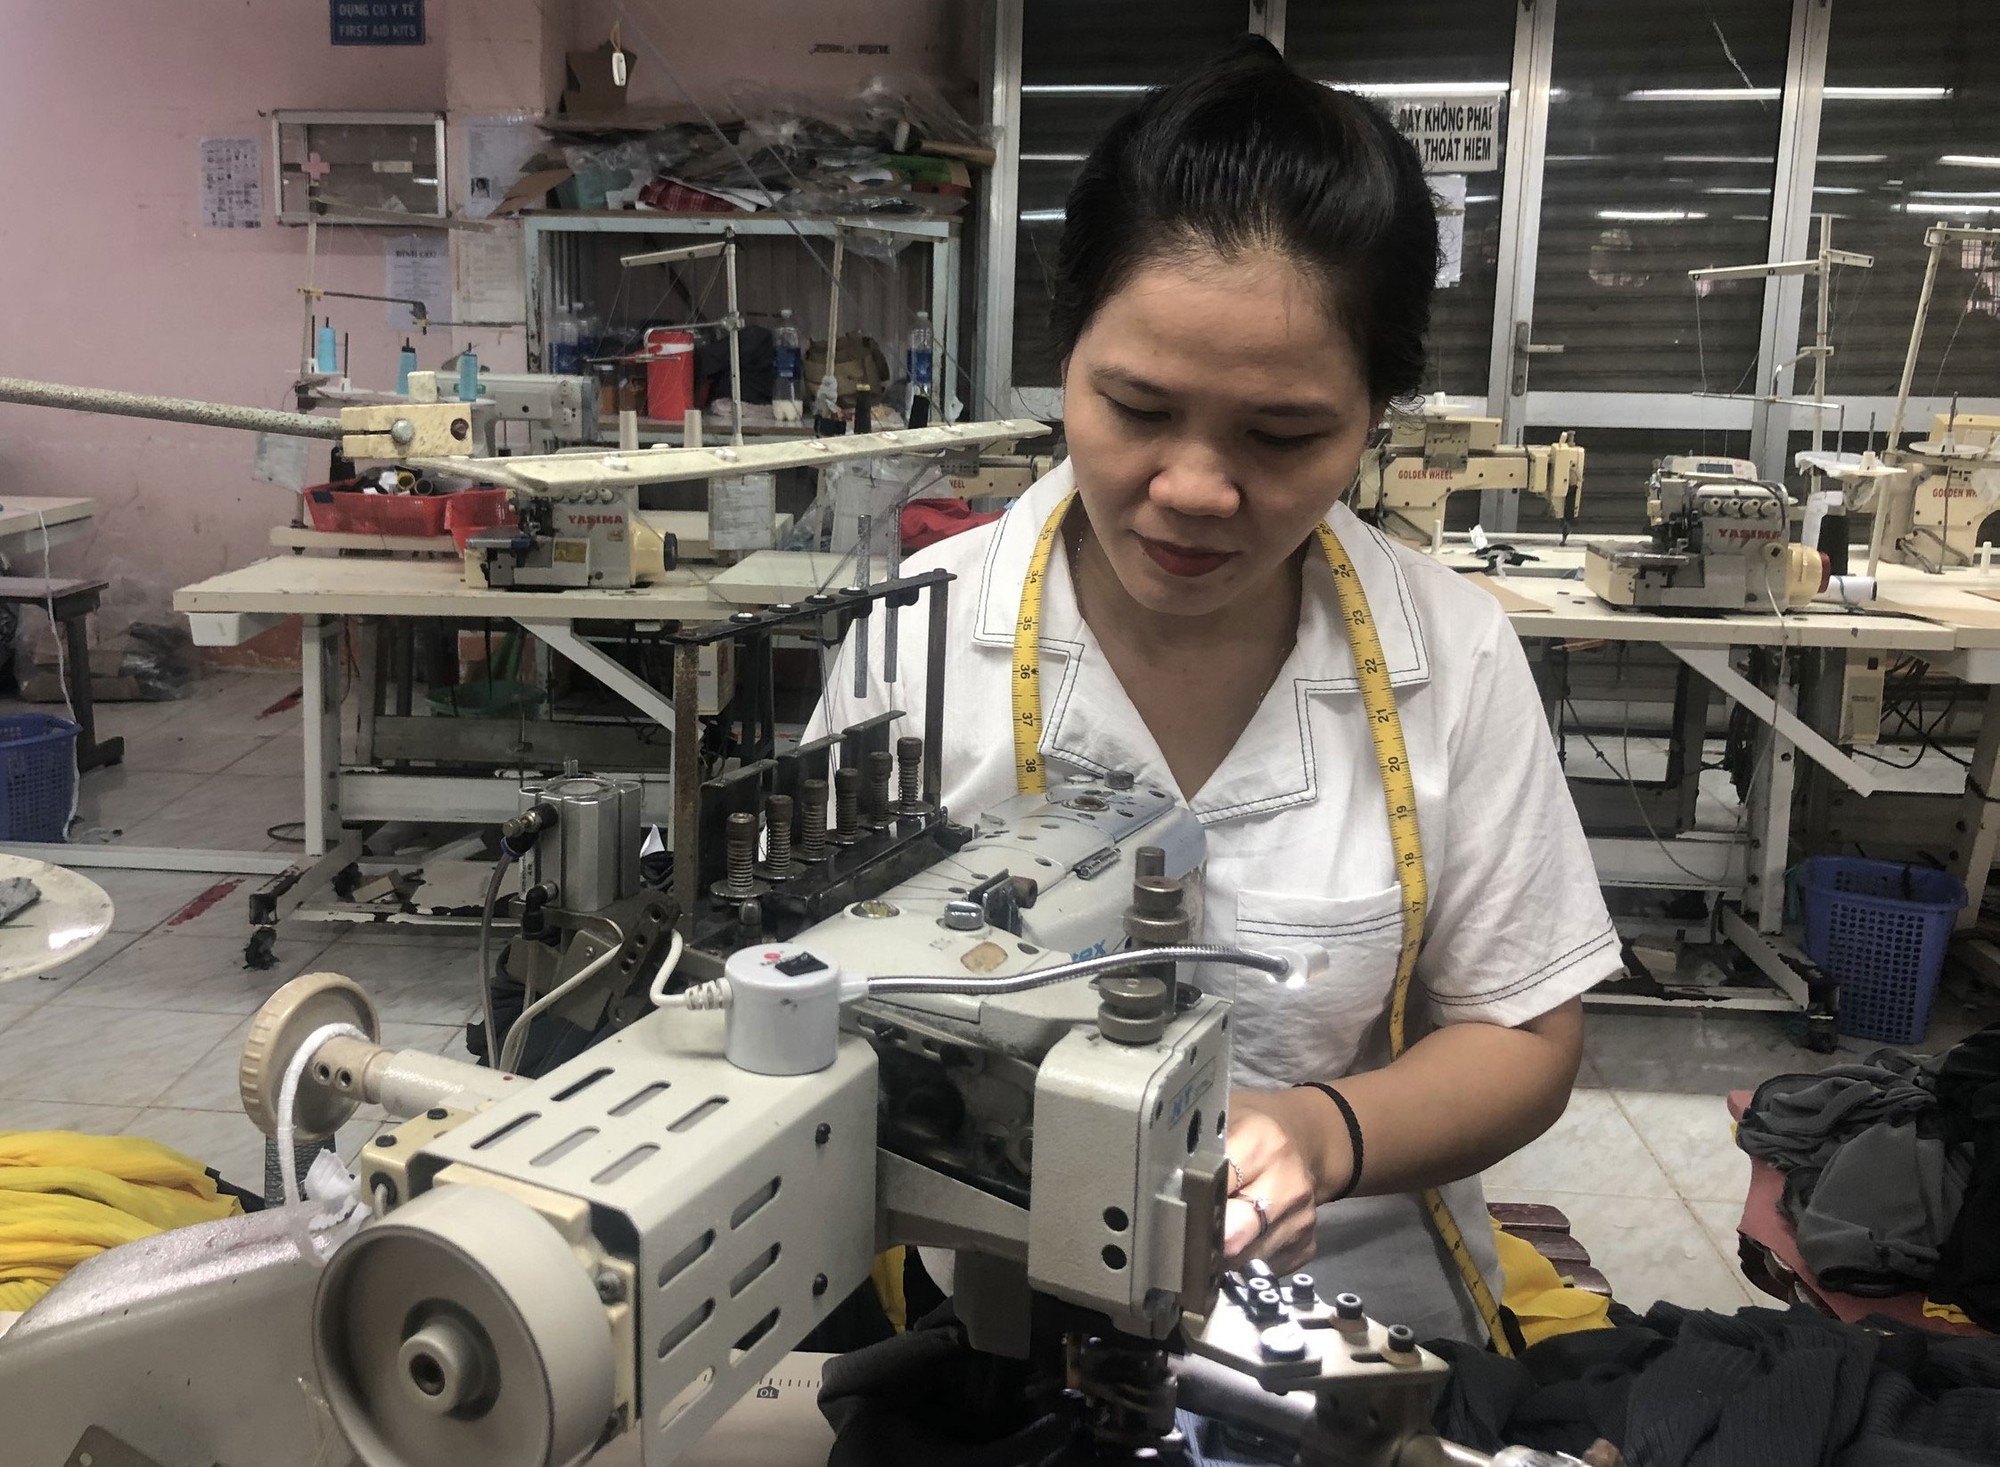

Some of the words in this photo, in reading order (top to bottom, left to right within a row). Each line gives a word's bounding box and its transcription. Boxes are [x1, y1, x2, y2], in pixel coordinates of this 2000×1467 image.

[340, 25, 368, 37] FIRST
[372, 25, 389, 37] AID
[392, 25, 417, 37] KITS
[1398, 470, 1427, 480] GOLDEN
[1429, 470, 1453, 480] WHEEL
[568, 515, 623, 524] YASIMA
[1030, 570, 1039, 584] 34
[1338, 564, 1351, 578] 24
[1022, 616, 1033, 631] 35
[1353, 609, 1365, 625] 23
[1020, 664, 1031, 680] 36
[1365, 658, 1377, 674] 22
[1022, 712, 1034, 727] 37
[1376, 708, 1390, 723] 21
[1025, 758, 1037, 773] 38
[1388, 756, 1400, 773] 20
[1396, 805, 1407, 820] 19
[1404, 852, 1415, 867] 18
[1412, 901, 1421, 913] 17
